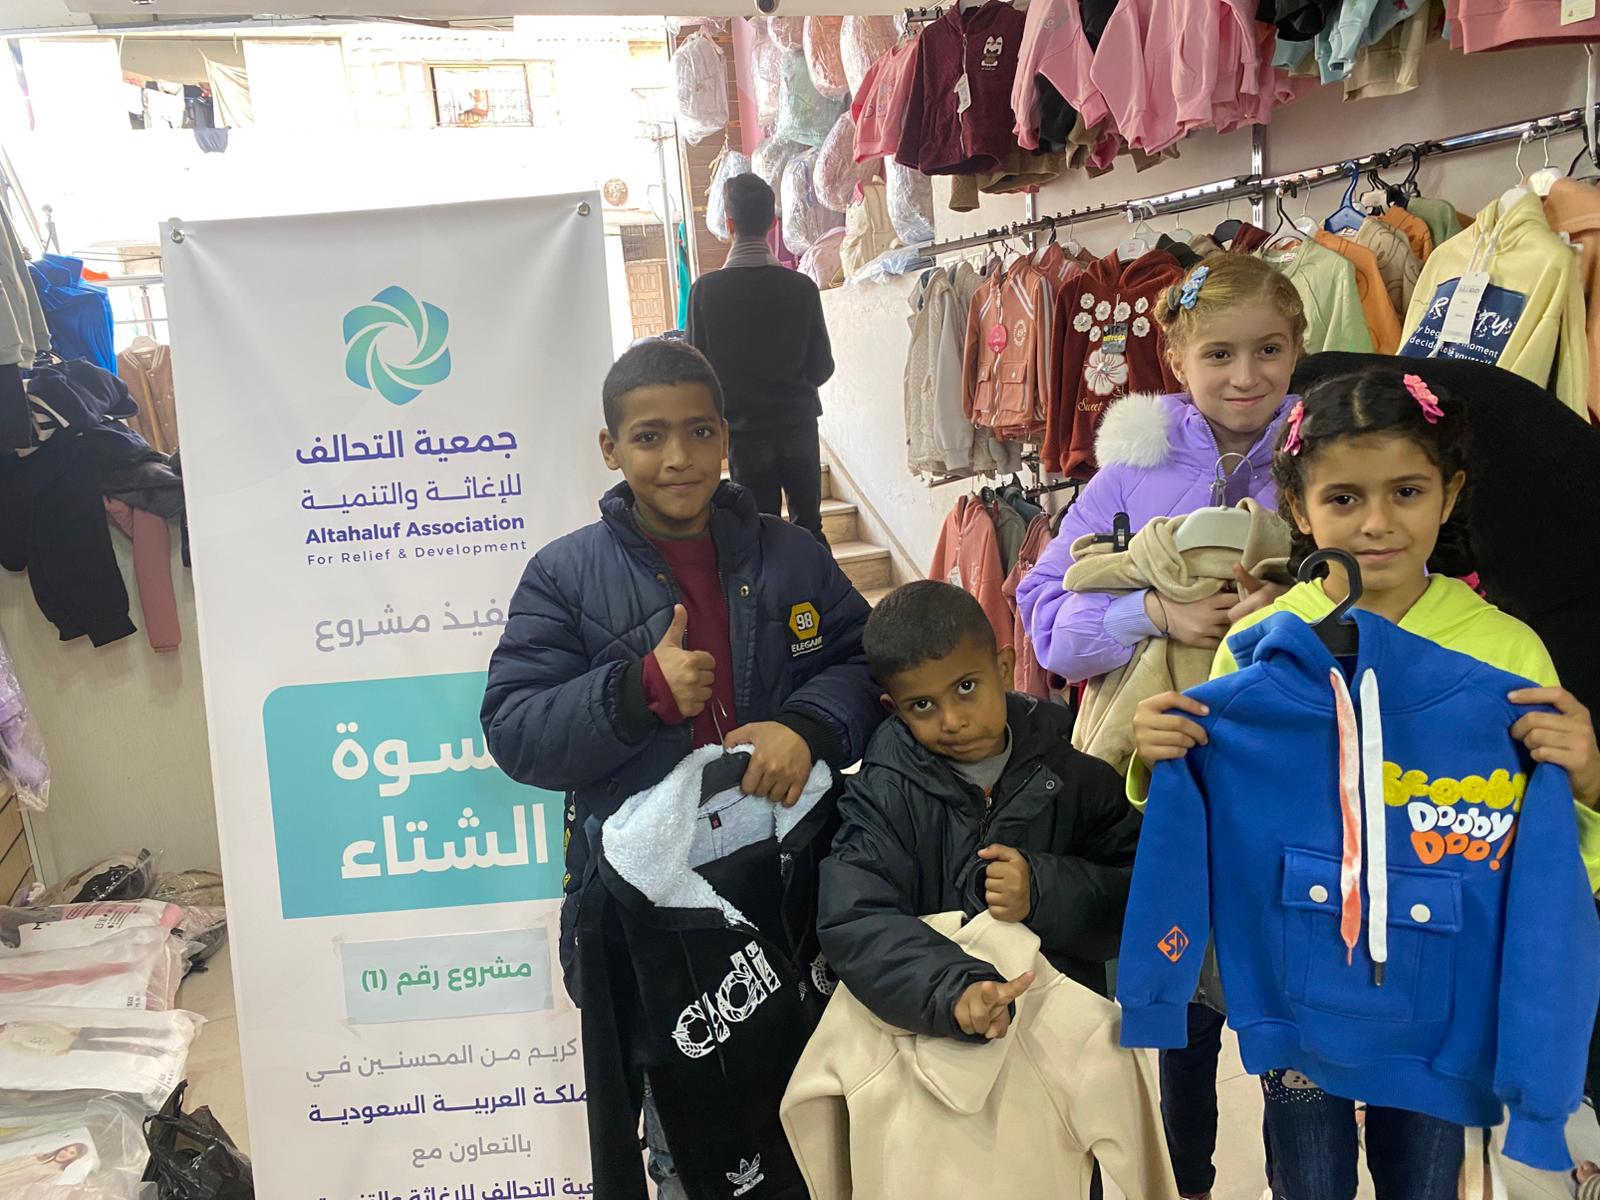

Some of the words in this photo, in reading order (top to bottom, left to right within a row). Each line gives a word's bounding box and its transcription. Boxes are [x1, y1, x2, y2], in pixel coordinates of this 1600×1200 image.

[295, 429, 404, 464] التحالف
[414, 428, 518, 464] جمعية
[301, 481, 419, 514] والتنمية
[305, 522, 400, 545] Altahaluf
[406, 514, 525, 538] Association
[307, 553, 333, 566] For
[341, 549, 391, 564] Relief
[398, 547, 408, 560] &
[415, 540, 527, 559] Development
[314, 603, 431, 652] مشروع
[442, 598, 508, 637] فيذ
[795, 611, 815, 631] 98
[331, 721, 499, 797] سوة
[1407, 801, 1514, 843] Dooby
[340, 803, 549, 879] الشتاء
[396, 964, 440, 996] رقم
[448, 956, 531, 992] مشروع
[357, 1044, 473, 1077] المحسنين
[480, 1046, 521, 1067] من
[527, 1038, 577, 1066] كريم
[305, 1054, 352, 1088] في
[308, 1094, 425, 1126] السعودية
[432, 1087, 526, 1115] العربية
[533, 1083, 587, 1105] ملكة
[411, 1146, 443, 1168] مع
[448, 1133, 532, 1165] بالتعاون
[481, 1177, 556, 1200] التحالف
